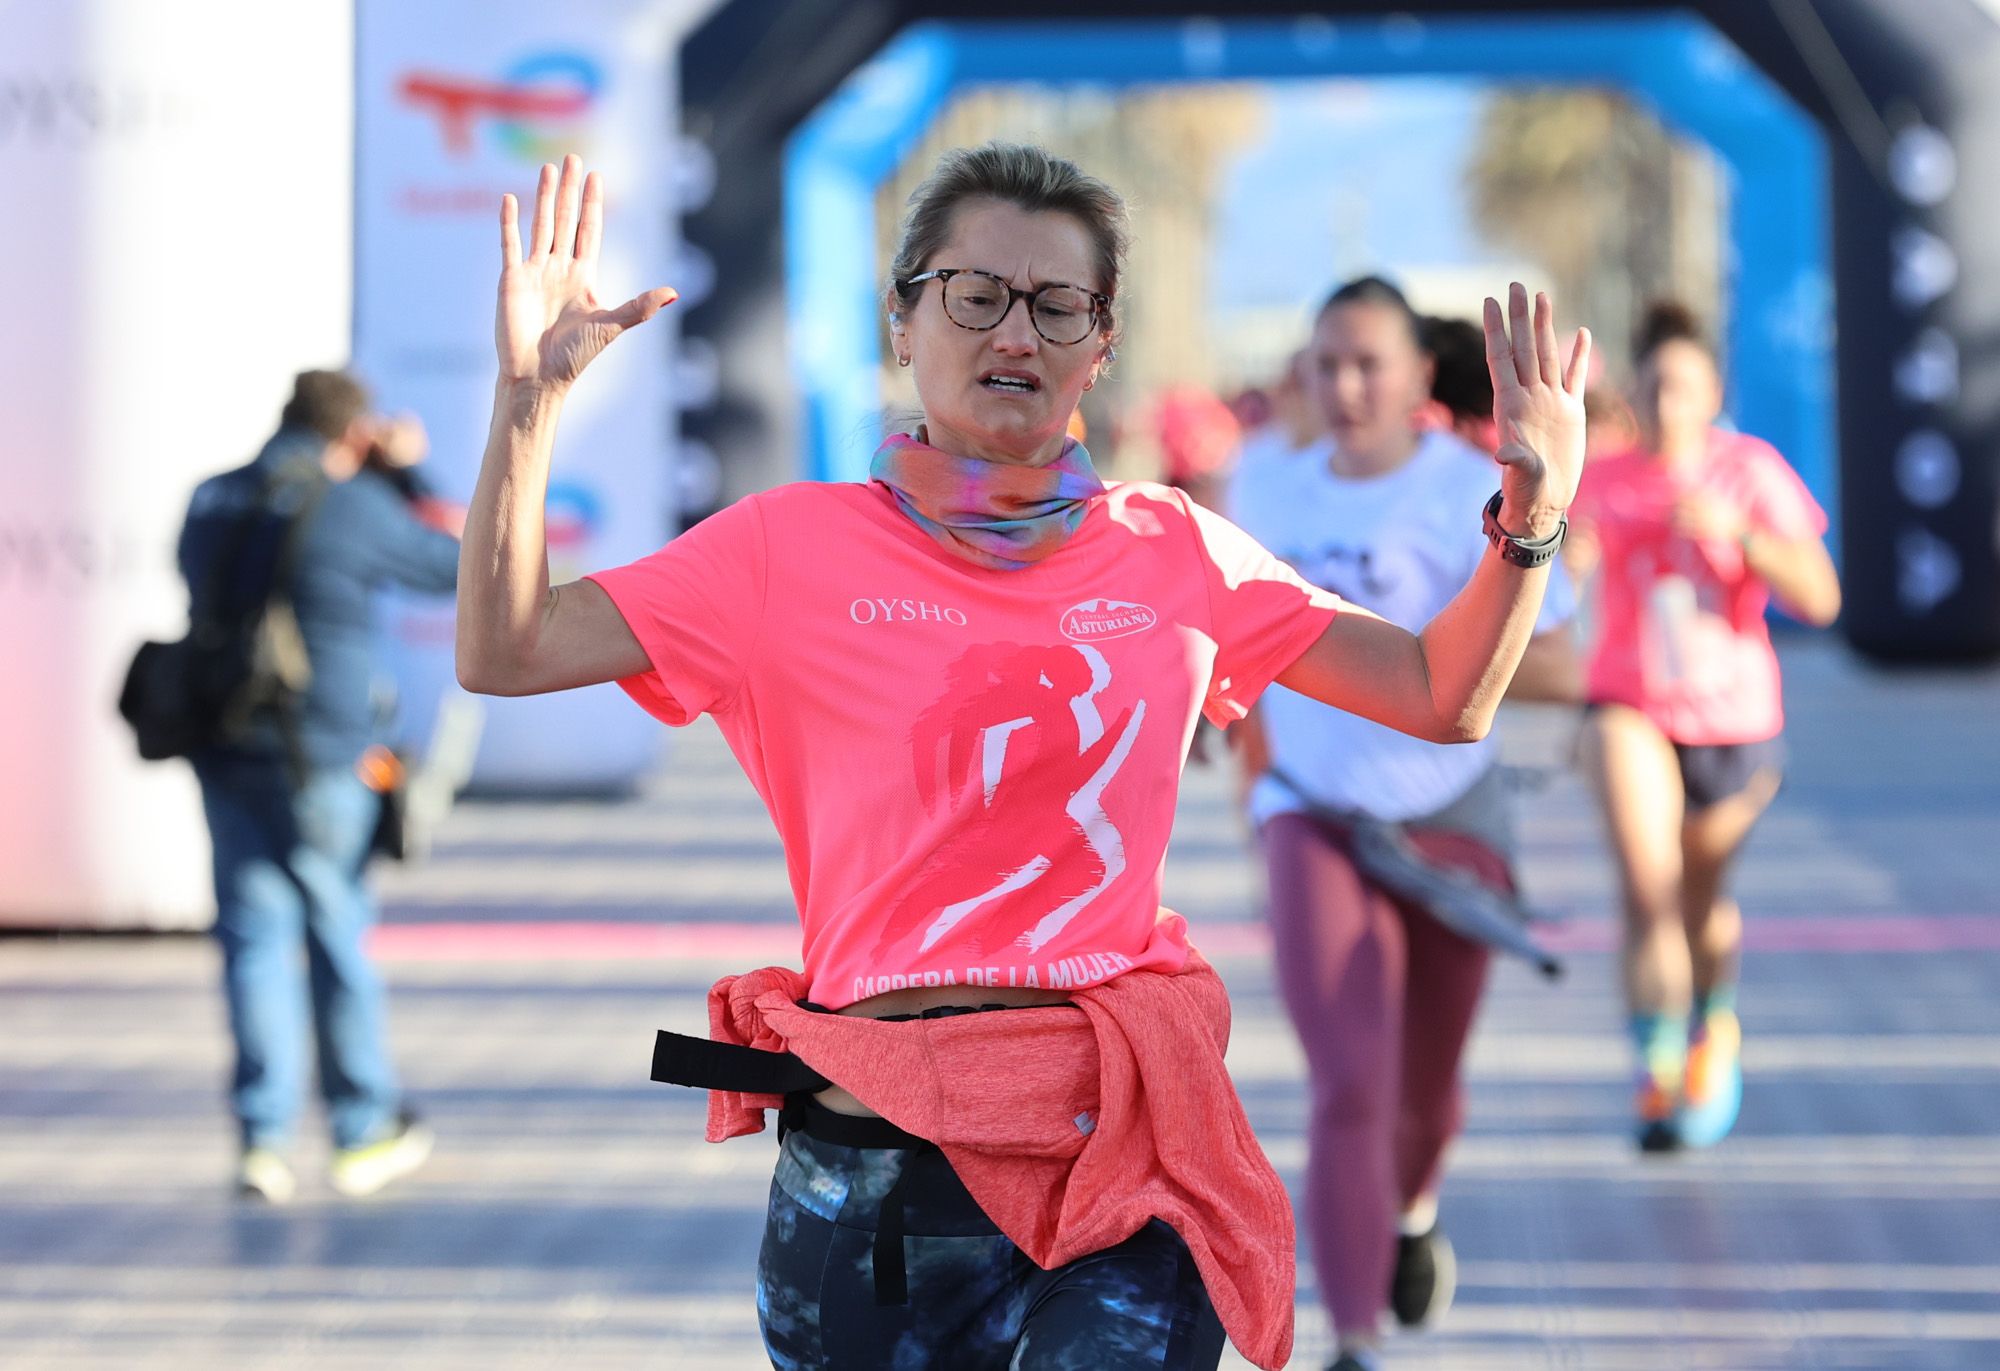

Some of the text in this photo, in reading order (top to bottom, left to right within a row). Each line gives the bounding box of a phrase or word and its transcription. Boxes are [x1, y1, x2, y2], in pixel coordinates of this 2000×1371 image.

[850, 598, 967, 626] OYSHO
[1069, 613, 1152, 635] ASTURIANA
[966, 967, 999, 987] DE
[1009, 964, 1040, 988] LA
[1048, 951, 1134, 989] MUJER
